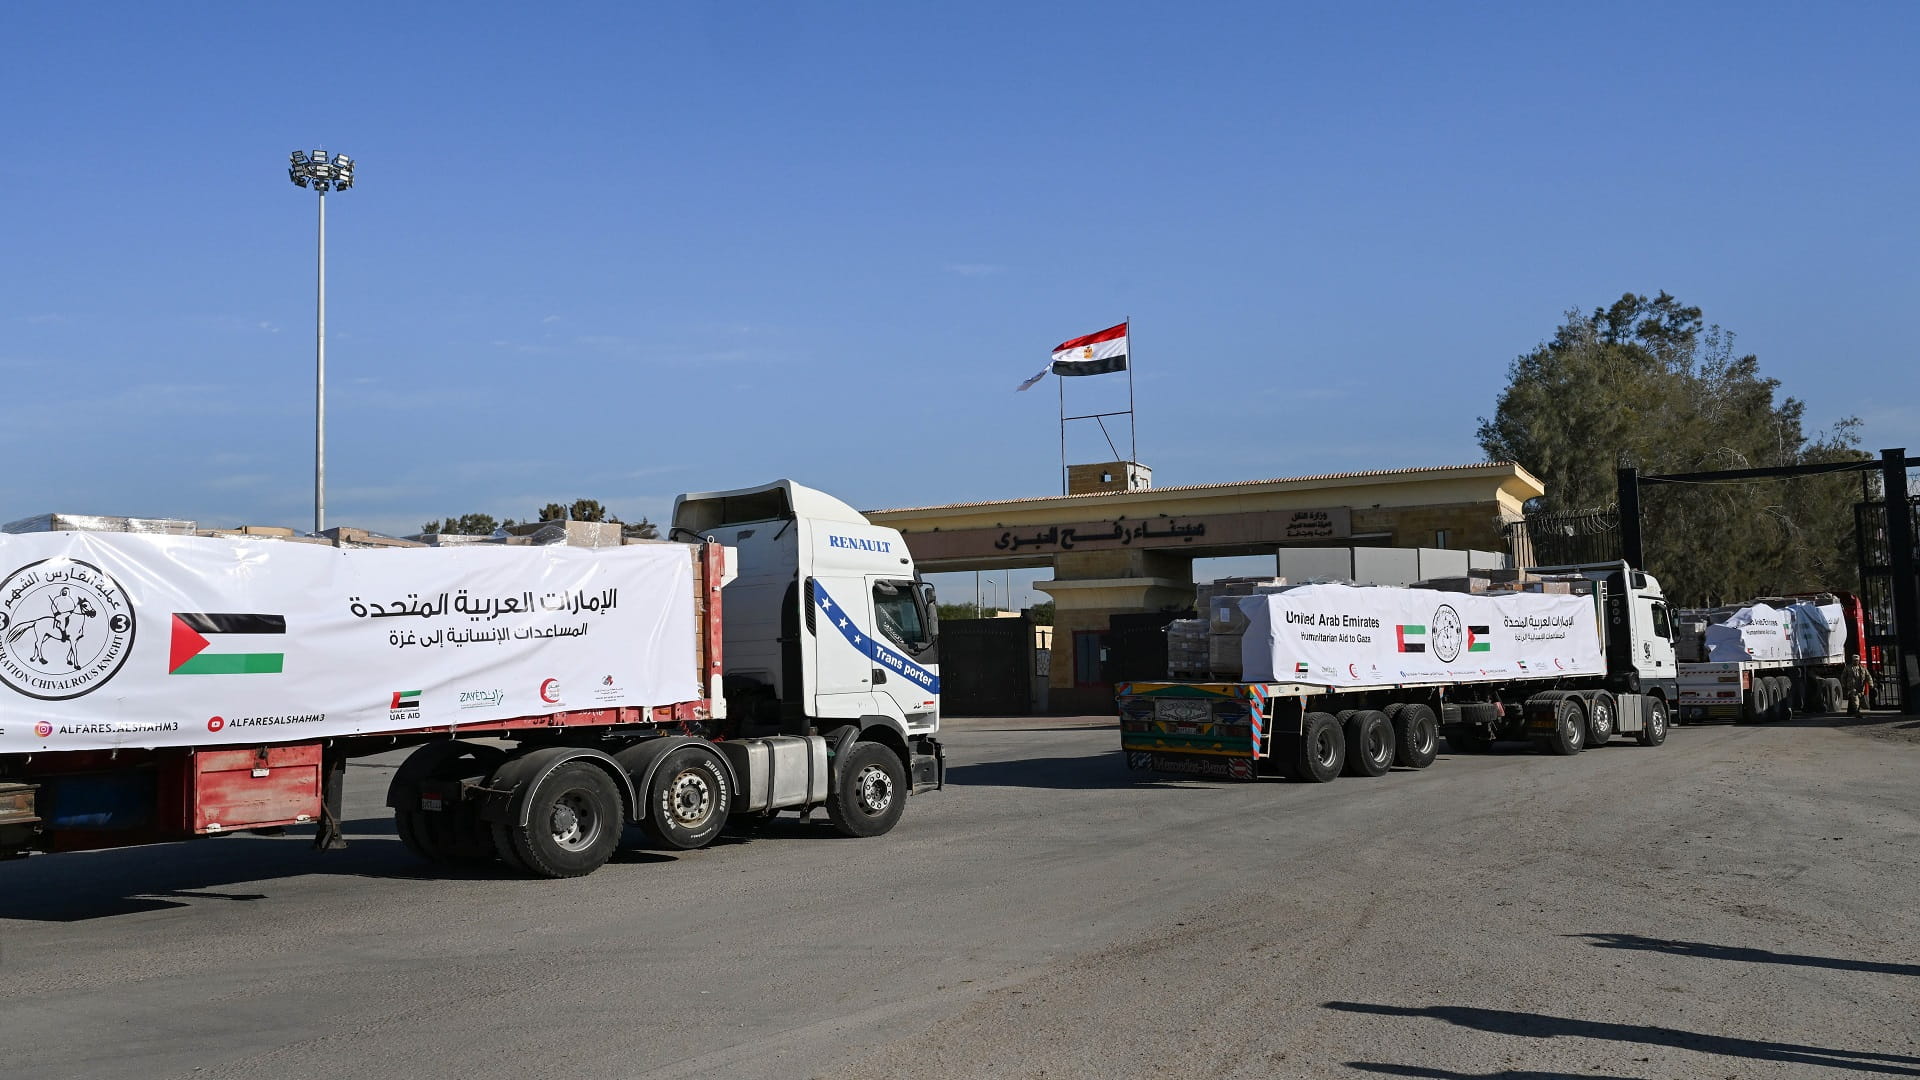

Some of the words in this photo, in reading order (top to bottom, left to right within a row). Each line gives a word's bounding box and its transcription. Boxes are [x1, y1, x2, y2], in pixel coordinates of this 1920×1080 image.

[829, 534, 891, 553] RENAULT
[4, 571, 40, 609] الشهم
[349, 592, 449, 619] المتحدة
[454, 589, 535, 622] العربية
[539, 587, 617, 615] الإمارات
[113, 615, 128, 633] 3
[1286, 610, 1315, 626] United
[1318, 613, 1340, 627] Arab
[1342, 615, 1380, 628] Emirates
[389, 629, 416, 649] غزة
[420, 629, 444, 648] إلى
[446, 626, 511, 648] الإنسانية
[514, 623, 588, 639] المساعدات
[1300, 631, 1338, 643] Humanitarian
[1338, 632, 1349, 643] Aid
[1349, 633, 1356, 643] to
[1356, 633, 1372, 644] Gaza
[31, 669, 99, 690] CHIVALROUS
[96, 634, 124, 672] KNIGHT
[875, 645, 903, 669] Trans
[903, 663, 933, 687] porter
[228, 713, 326, 728] ALFARESALSHAHM3
[389, 713, 406, 721] UAE
[407, 712, 421, 720] AID
[58, 721, 179, 734] ALFARES.ALSHAHM3
